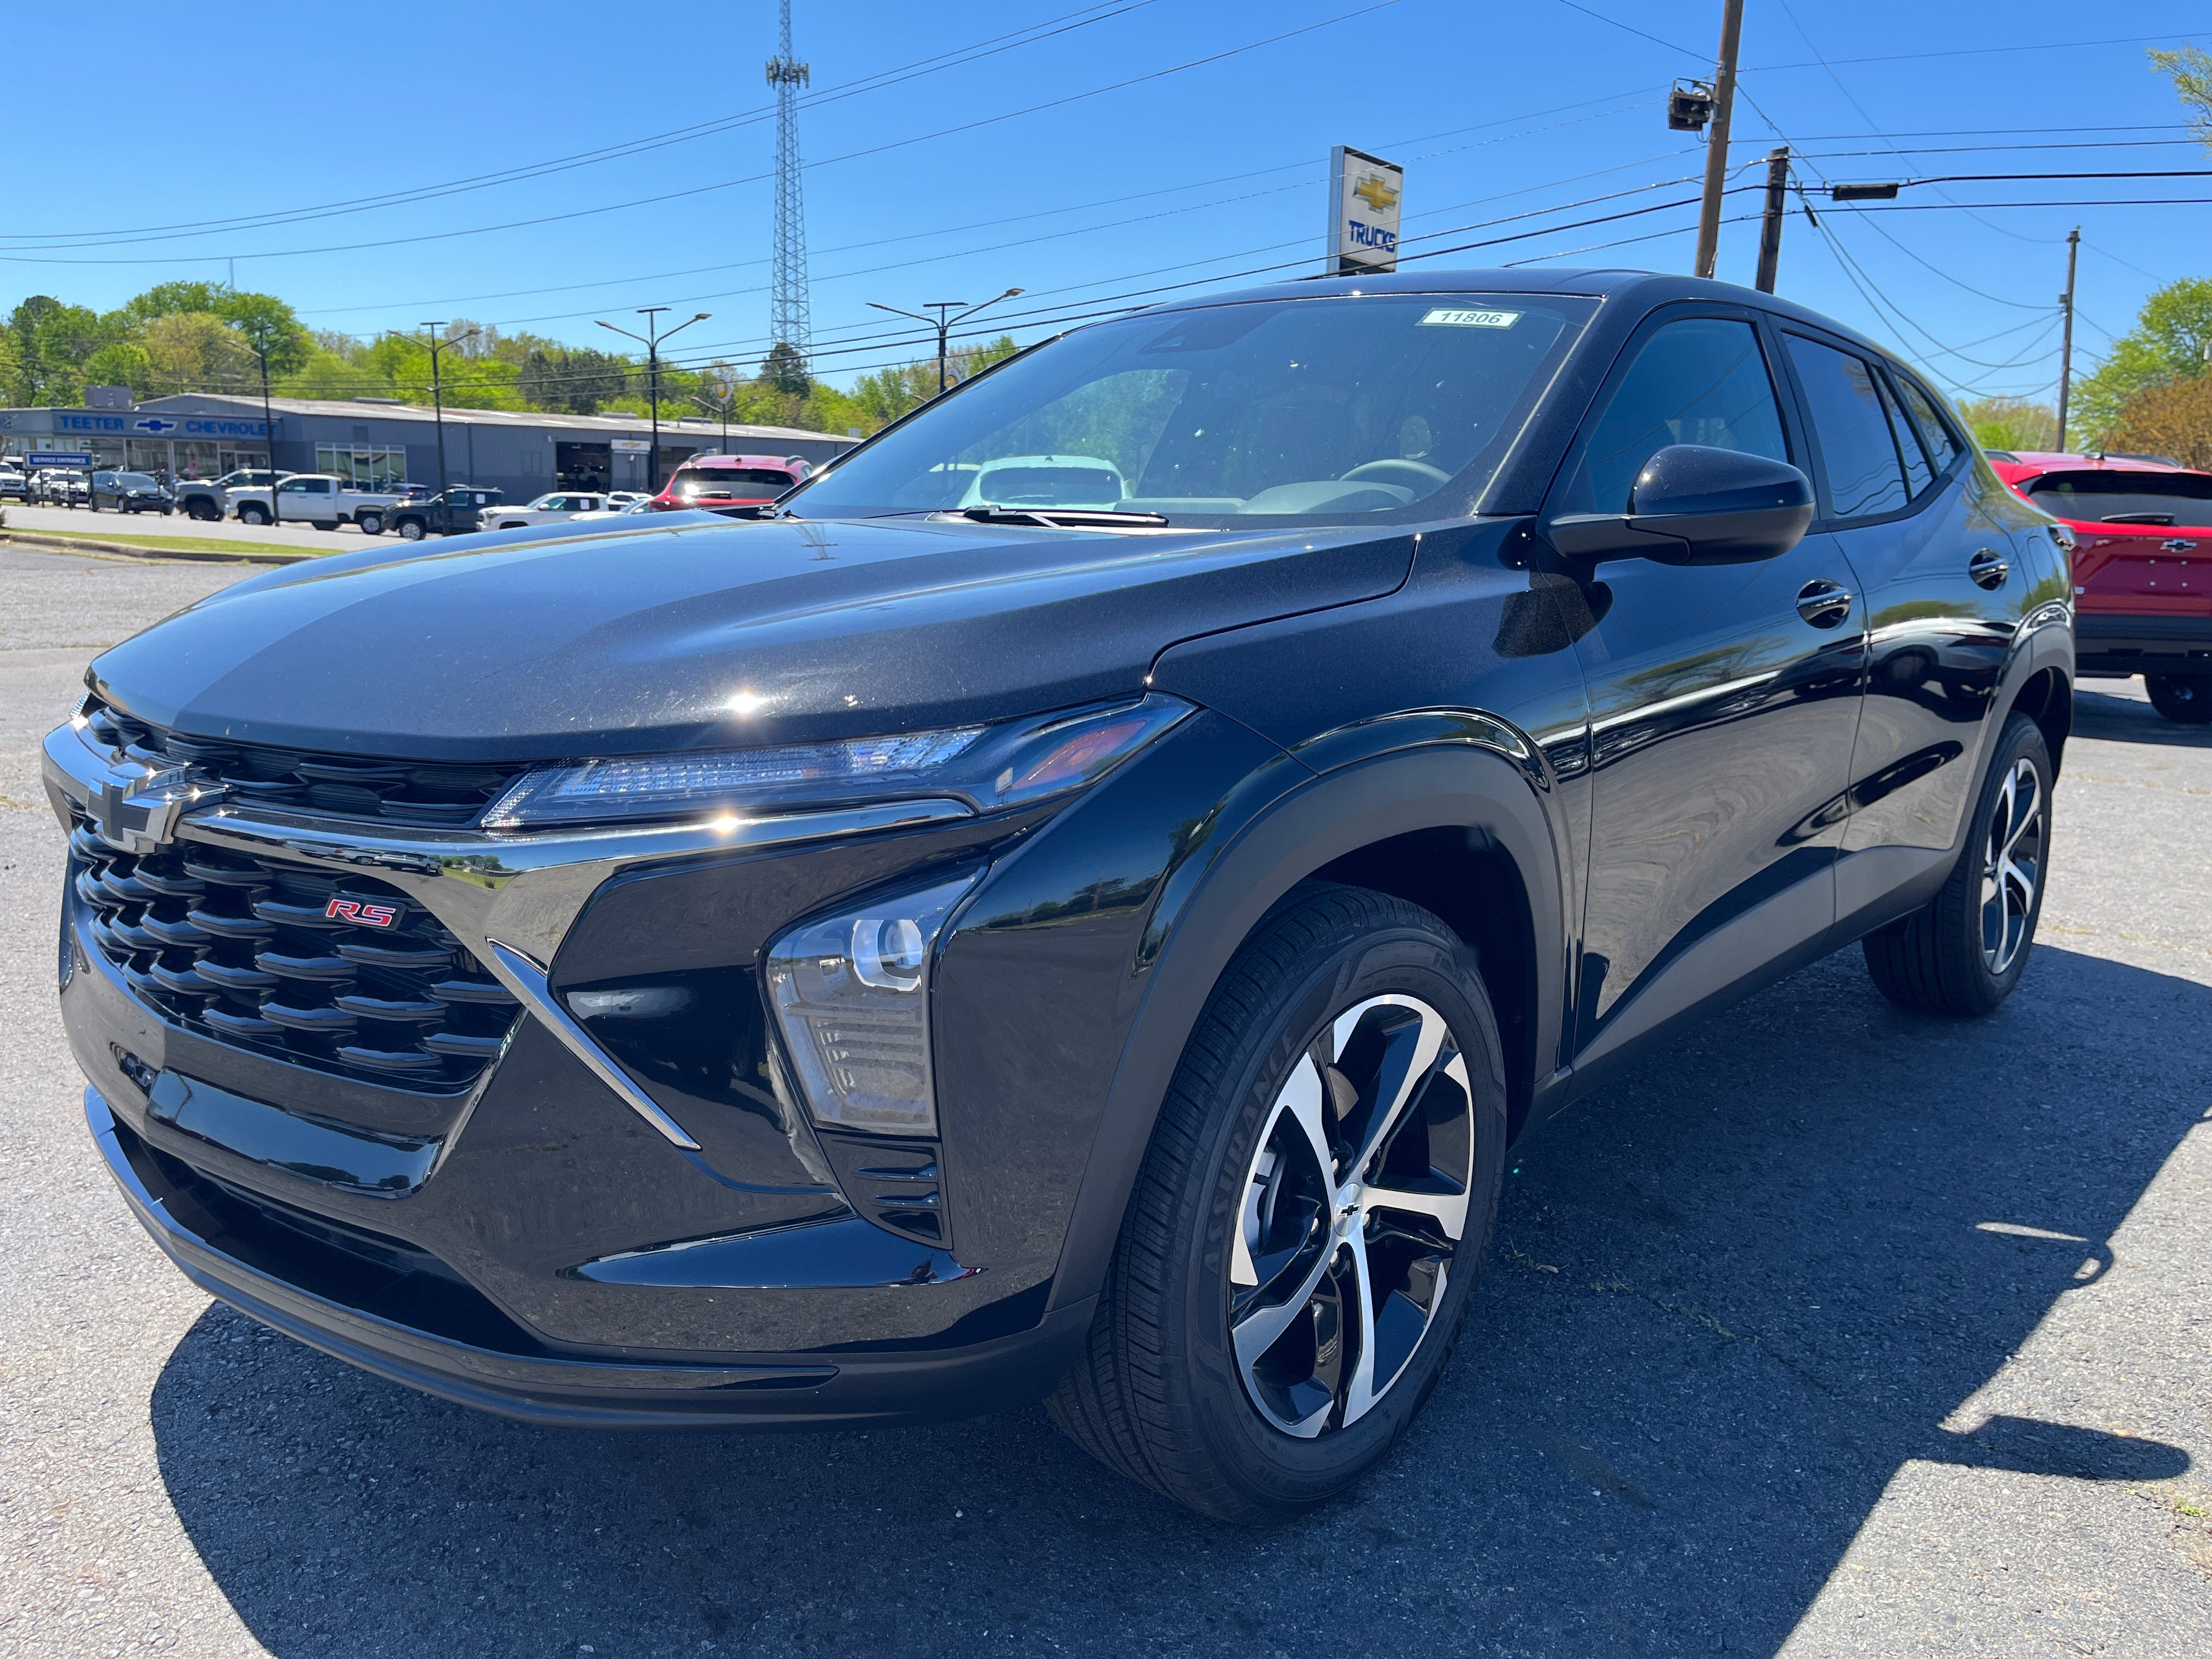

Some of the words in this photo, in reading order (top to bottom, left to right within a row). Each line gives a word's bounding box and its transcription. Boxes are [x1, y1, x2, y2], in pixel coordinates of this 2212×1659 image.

[1348, 219, 1396, 253] TRUCKS
[1441, 312, 1503, 324] 11806
[60, 415, 125, 430] TEETER
[325, 899, 397, 927] RS
[1204, 1025, 1297, 1274] ASSURANCE
